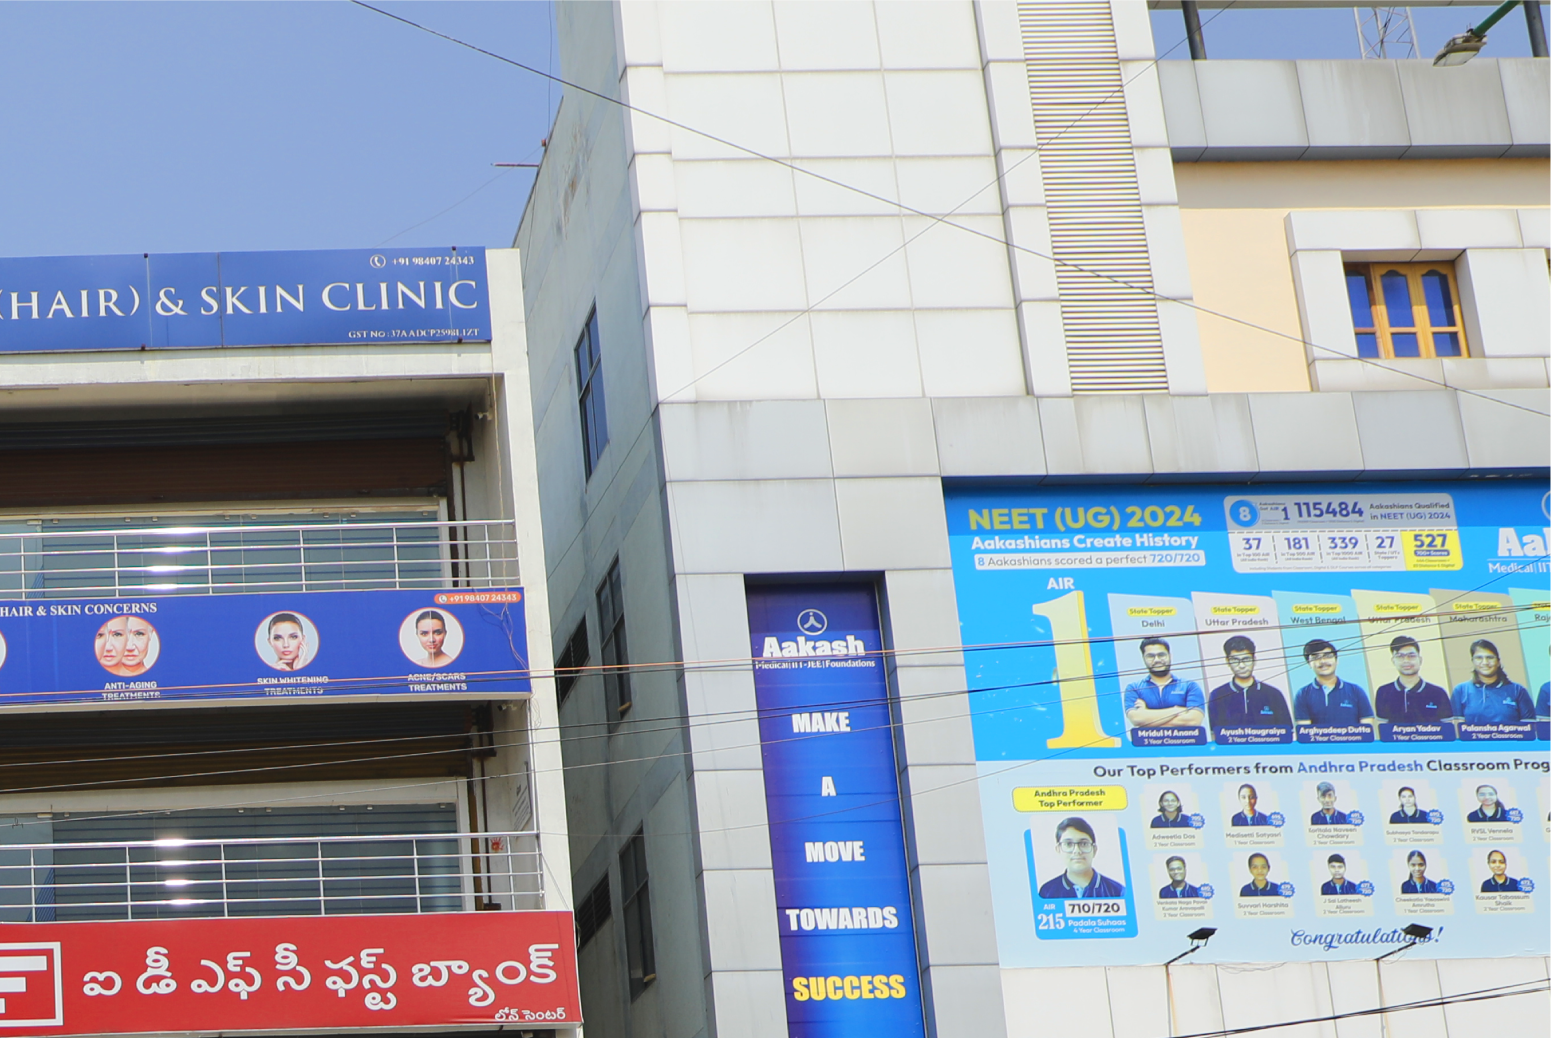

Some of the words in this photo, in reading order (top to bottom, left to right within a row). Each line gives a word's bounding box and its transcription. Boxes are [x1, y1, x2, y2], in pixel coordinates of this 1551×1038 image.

[155, 286, 189, 317] &
[200, 285, 305, 316] SKIN
[321, 279, 479, 312] CLINIC
[1238, 506, 1251, 521] 8
[1293, 501, 1364, 518] 115484
[1380, 512, 1404, 520] NEET
[1406, 512, 1427, 520] (UG)
[968, 508, 1048, 530] NEET
[1055, 506, 1121, 532] (UG)
[1125, 505, 1202, 528] 2024
[971, 535, 1070, 550] Aakashians
[1073, 534, 1132, 549] Create
[1135, 533, 1199, 549] History
[1242, 537, 1262, 550] 37
[1284, 536, 1310, 550] 181
[1327, 536, 1359, 550] 339
[1375, 536, 1395, 549] 27
[1413, 533, 1448, 549] 527
[977, 556, 985, 566] 8
[988, 556, 1052, 567] Aakashians
[1054, 555, 1094, 566] scored
[1096, 557, 1103, 566] a
[1105, 554, 1147, 567] perfect
[1149, 552, 1201, 566] 720/720
[1488, 562, 1533, 573] Medical
[1047, 577, 1076, 590] AIR
[0, 605, 34, 618] HAIR
[36, 605, 47, 617] &
[49, 604, 81, 617] SKIN
[84, 602, 158, 616] CONCERNS
[1141, 620, 1165, 628] Delhi
[1205, 618, 1230, 626] Uttar
[1232, 618, 1269, 626] Pradesh
[1290, 616, 1313, 624] West
[1450, 614, 1508, 624] Maharashtra
[763, 634, 866, 658] Aakash
[1032, 590, 1122, 749] 1
[104, 680, 158, 690] ANTI-AGING
[257, 676, 278, 686] SKIN
[280, 674, 329, 685] WHITENING
[408, 682, 468, 692] TREATMENTS
[791, 711, 851, 733] MAKE
[1172, 728, 1199, 737] Anand
[1093, 766, 1123, 778] Our
[1127, 765, 1157, 779] Top
[1160, 763, 1251, 777] Performers
[1254, 762, 1294, 774] from
[1297, 761, 1355, 774] Andhra
[1358, 760, 1423, 773] Pradesh
[1426, 759, 1511, 773] Classroom
[821, 776, 837, 797] A
[1034, 789, 1068, 798] Andhra
[1070, 788, 1106, 797] Pradesh
[1039, 799, 1056, 808] Top
[1058, 798, 1103, 808] Performer
[804, 840, 866, 863] MOVE
[1068, 902, 1121, 914] 710/720
[785, 906, 899, 931] TOWARDS
[1037, 912, 1066, 930] 215
[82, 969, 122, 997] ఐ
[136, 946, 178, 996] డీ
[190, 951, 262, 1001] ఎఫ్
[275, 943, 312, 994] సీ
[411, 943, 560, 1007] బ్యాంక్
[792, 974, 907, 1002] SUCCESS
[494, 1006, 520, 1021] లోన్
[521, 1006, 567, 1021] సెంటర్
